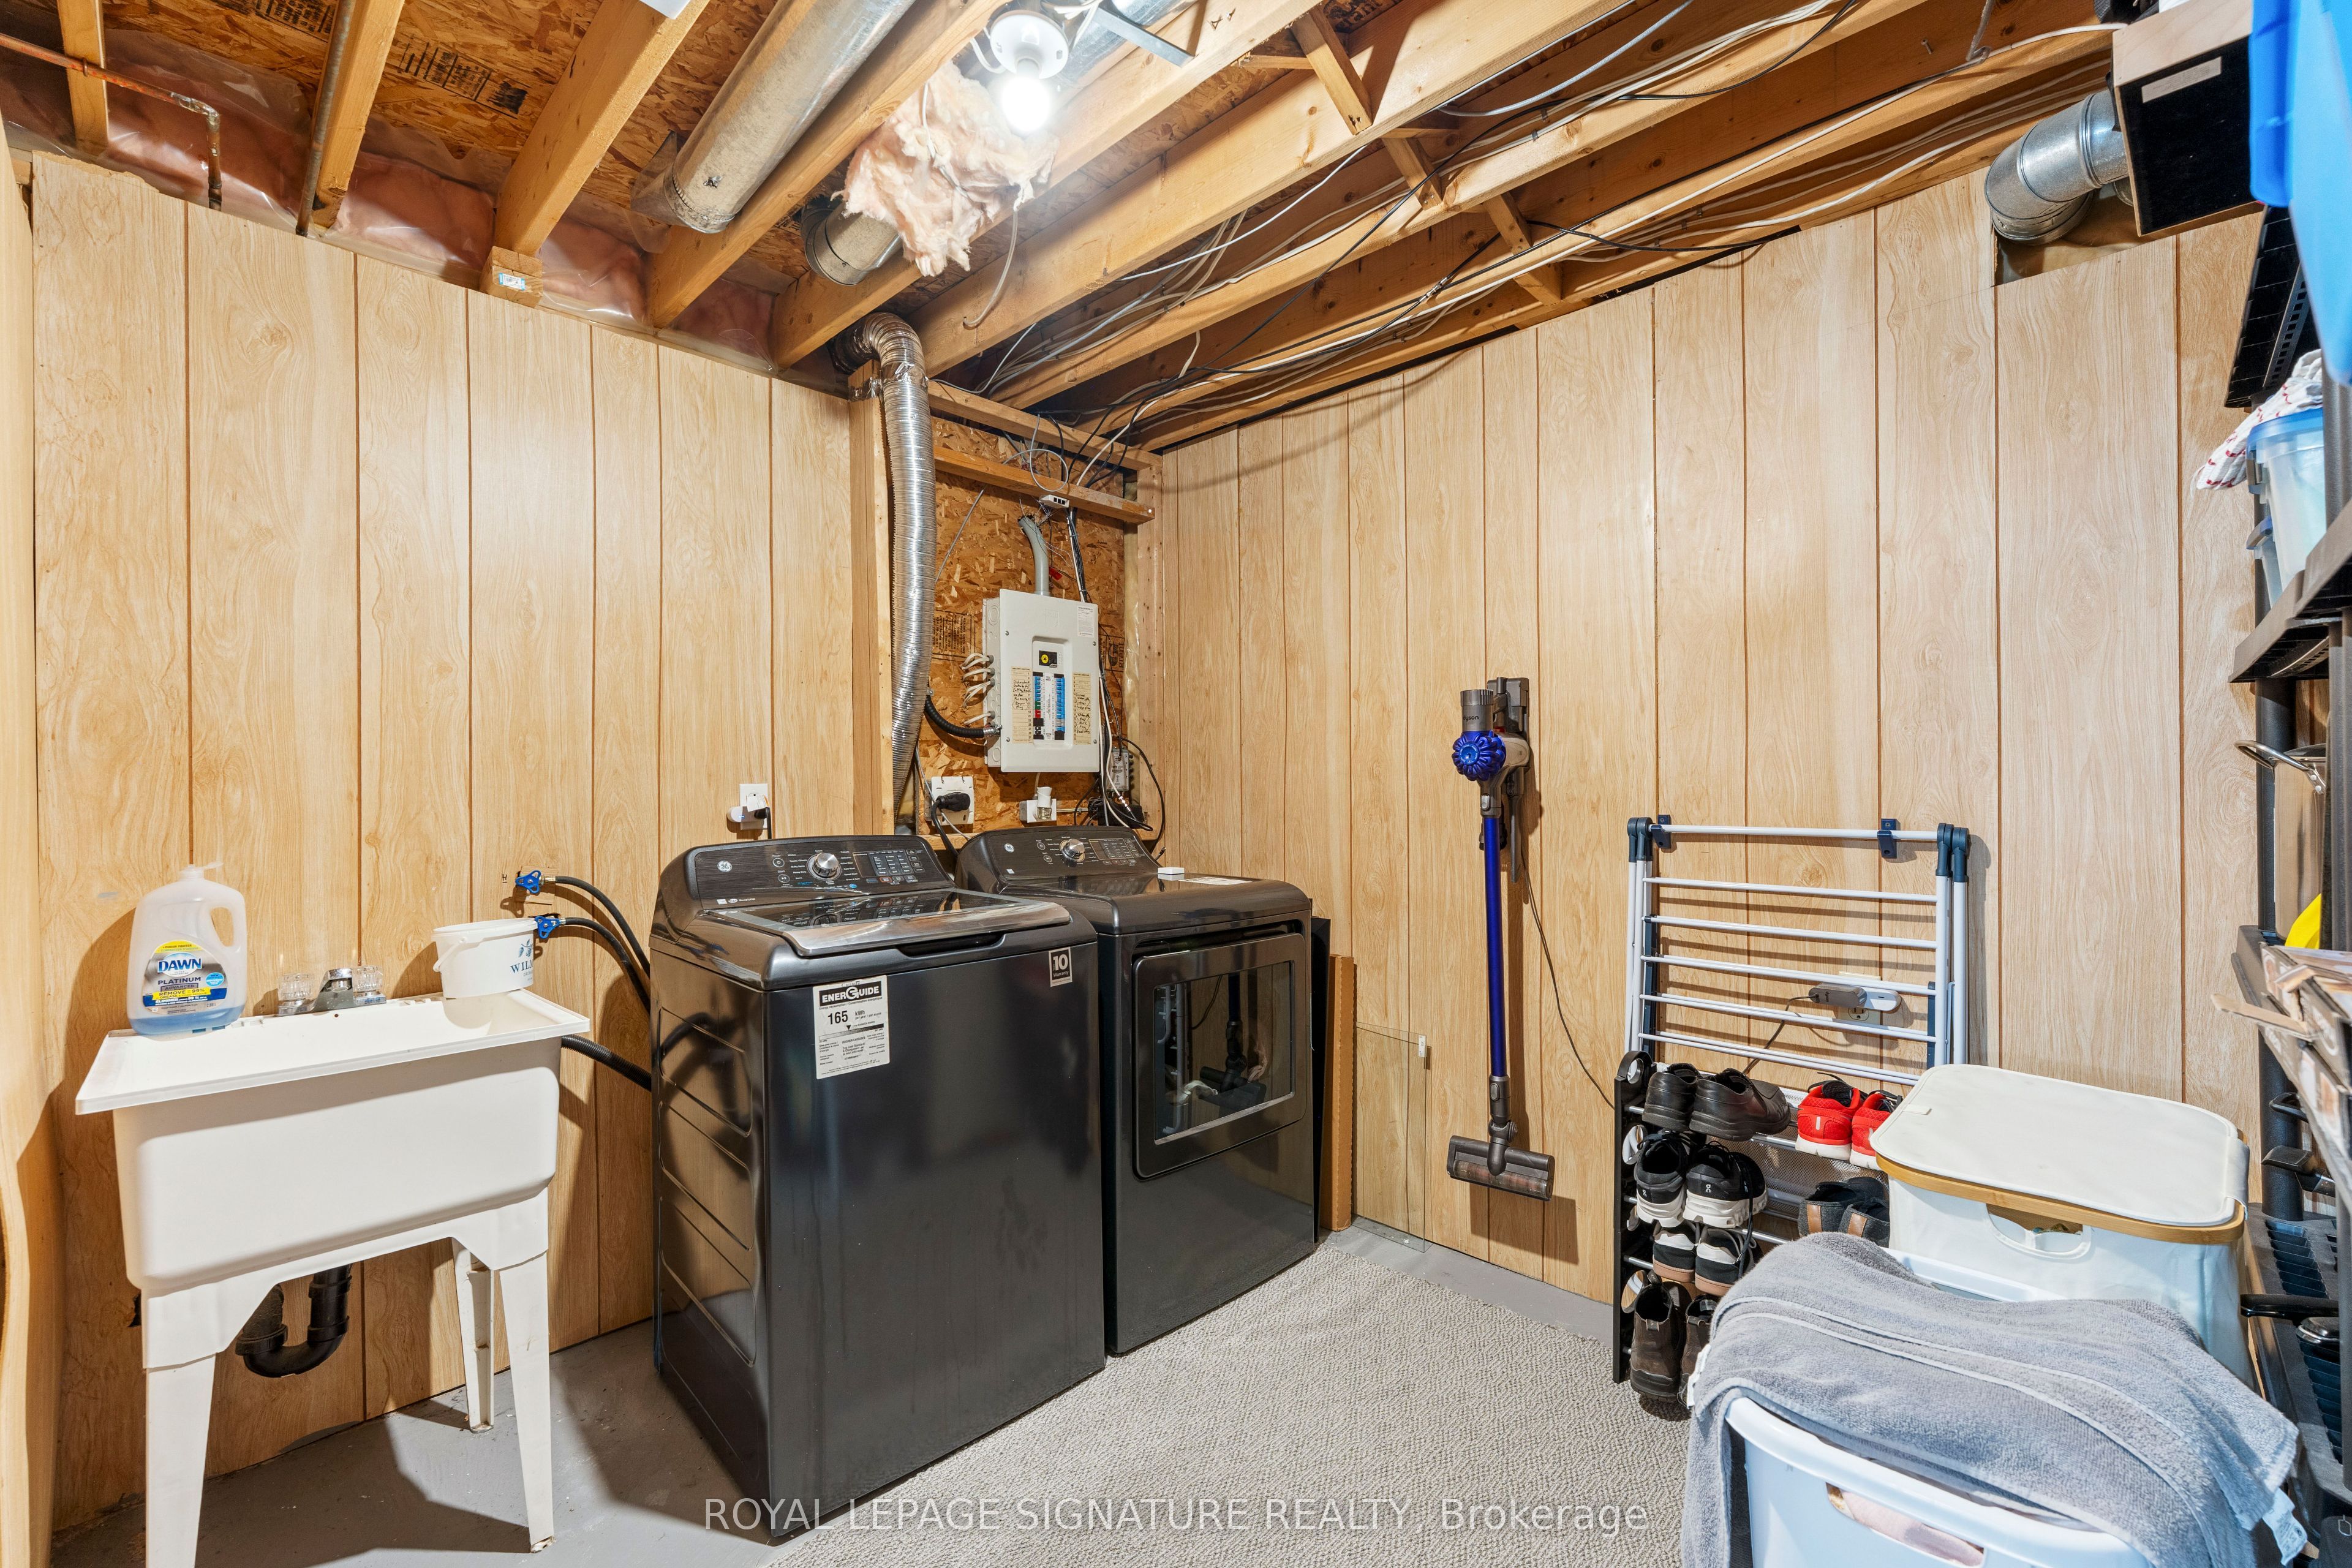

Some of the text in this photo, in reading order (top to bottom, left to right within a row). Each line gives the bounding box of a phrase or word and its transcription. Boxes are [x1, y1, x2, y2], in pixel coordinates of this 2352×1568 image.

[158, 958, 202, 972] DAWN
[1054, 954, 1068, 971] 10
[157, 976, 201, 985] PLATINUM
[821, 986, 880, 1003] ENERGUIDE
[827, 1011, 848, 1025] 165
